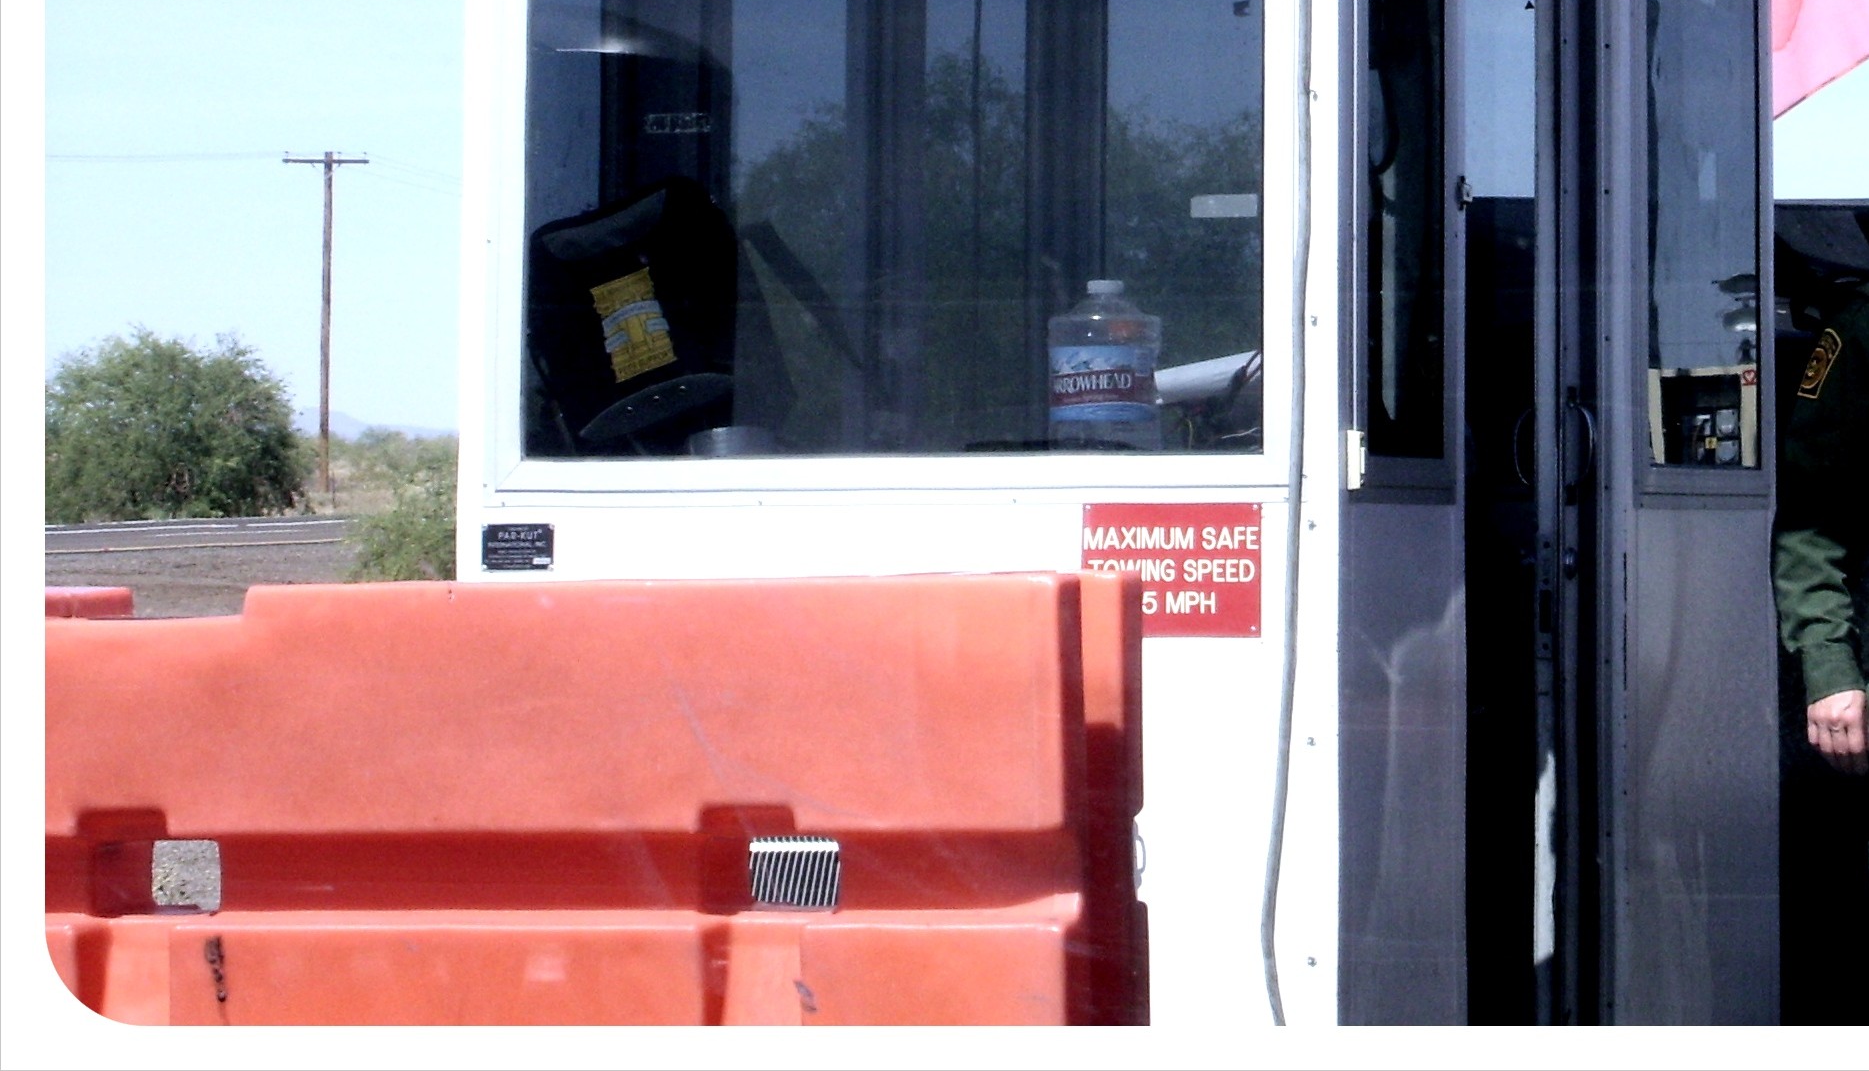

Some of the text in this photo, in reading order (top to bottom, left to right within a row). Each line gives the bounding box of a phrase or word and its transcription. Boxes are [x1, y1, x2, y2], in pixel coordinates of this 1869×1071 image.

[1083, 526, 1259, 550] MAXIMUM SAFE
[1183, 559, 1255, 582] SPEED
[1165, 591, 1216, 615] MPH
